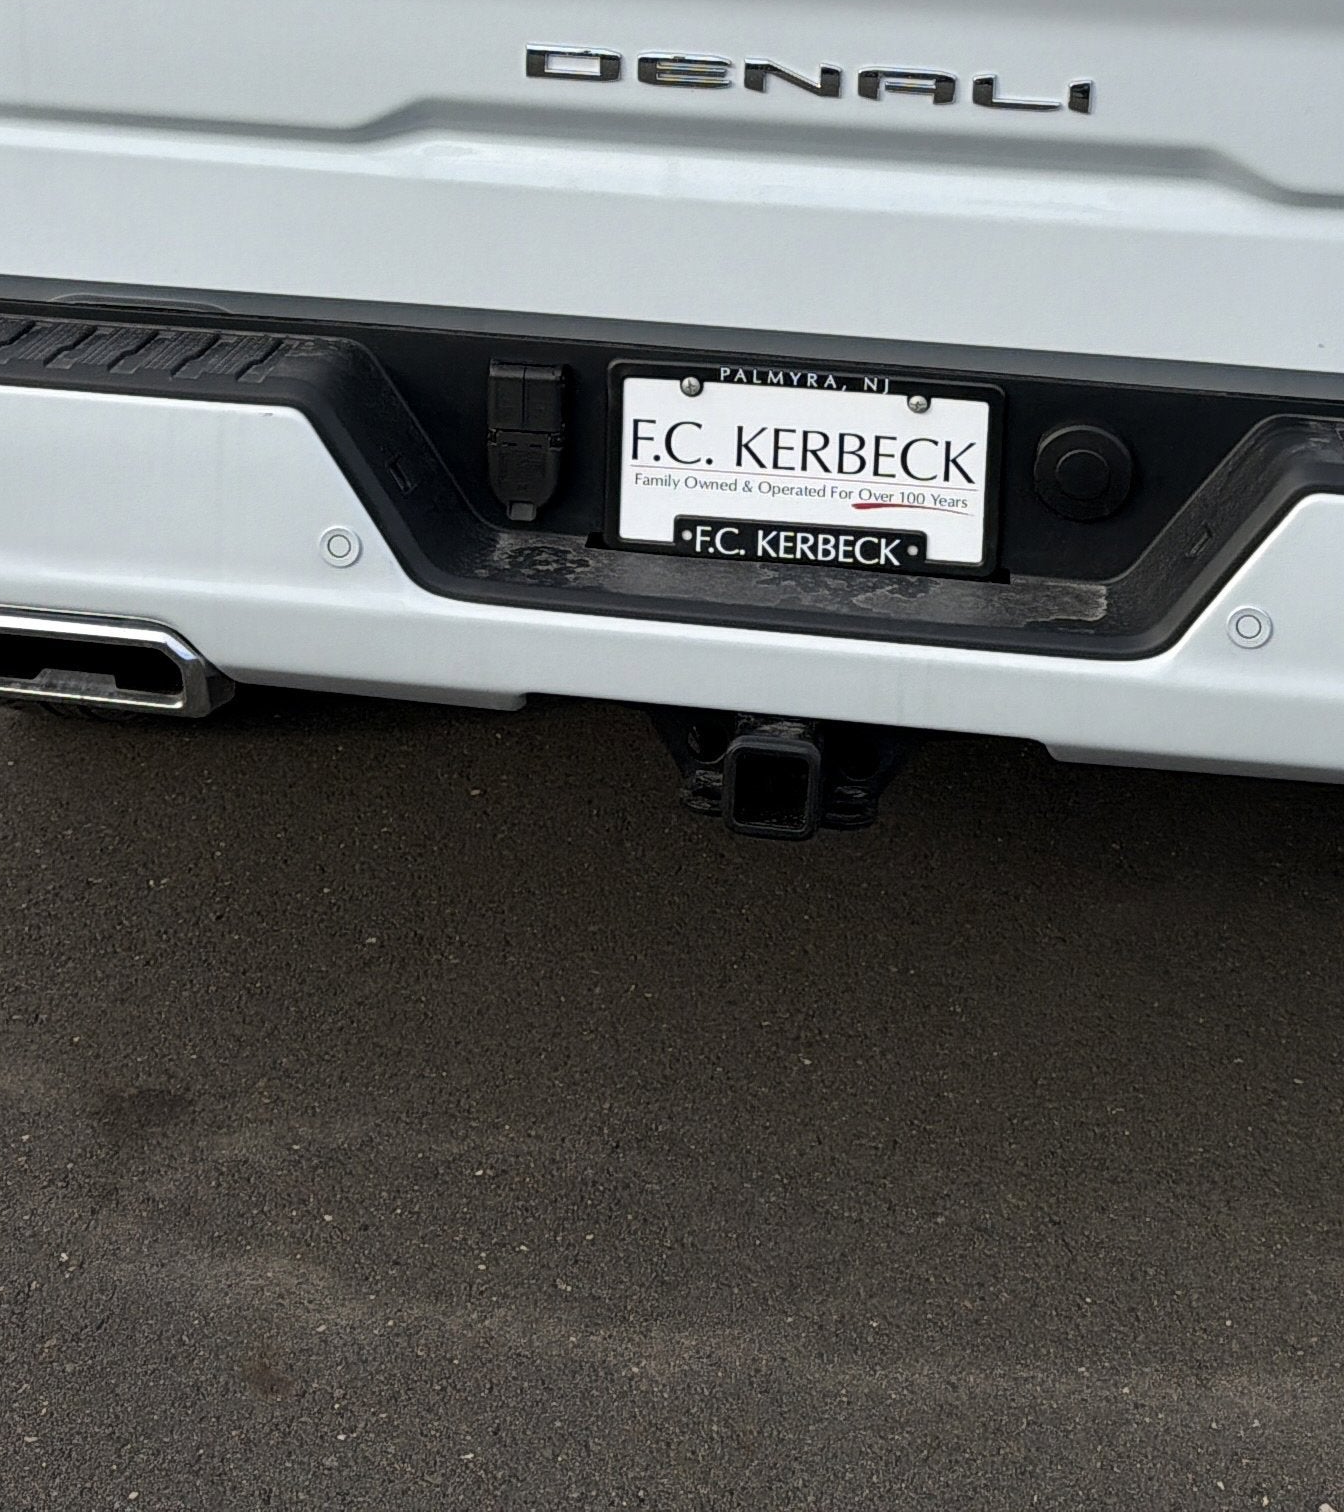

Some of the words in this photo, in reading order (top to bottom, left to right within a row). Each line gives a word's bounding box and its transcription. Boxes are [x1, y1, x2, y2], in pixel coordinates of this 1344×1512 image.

[525, 42, 1095, 115] DENALI
[719, 366, 848, 392] PALMYRA,
[863, 377, 891, 395] NJ
[630, 418, 714, 466] F.C.
[735, 424, 977, 485] KERBECK
[634, 472, 681, 491] Family
[684, 474, 738, 493] Owned
[741, 478, 754, 494] &
[757, 480, 827, 501] Operated
[830, 486, 854, 501] For
[858, 487, 894, 504] Over
[898, 490, 926, 506] 100
[930, 493, 969, 509] Years
[694, 525, 747, 556] F.C.
[756, 529, 902, 567] KERBECK
